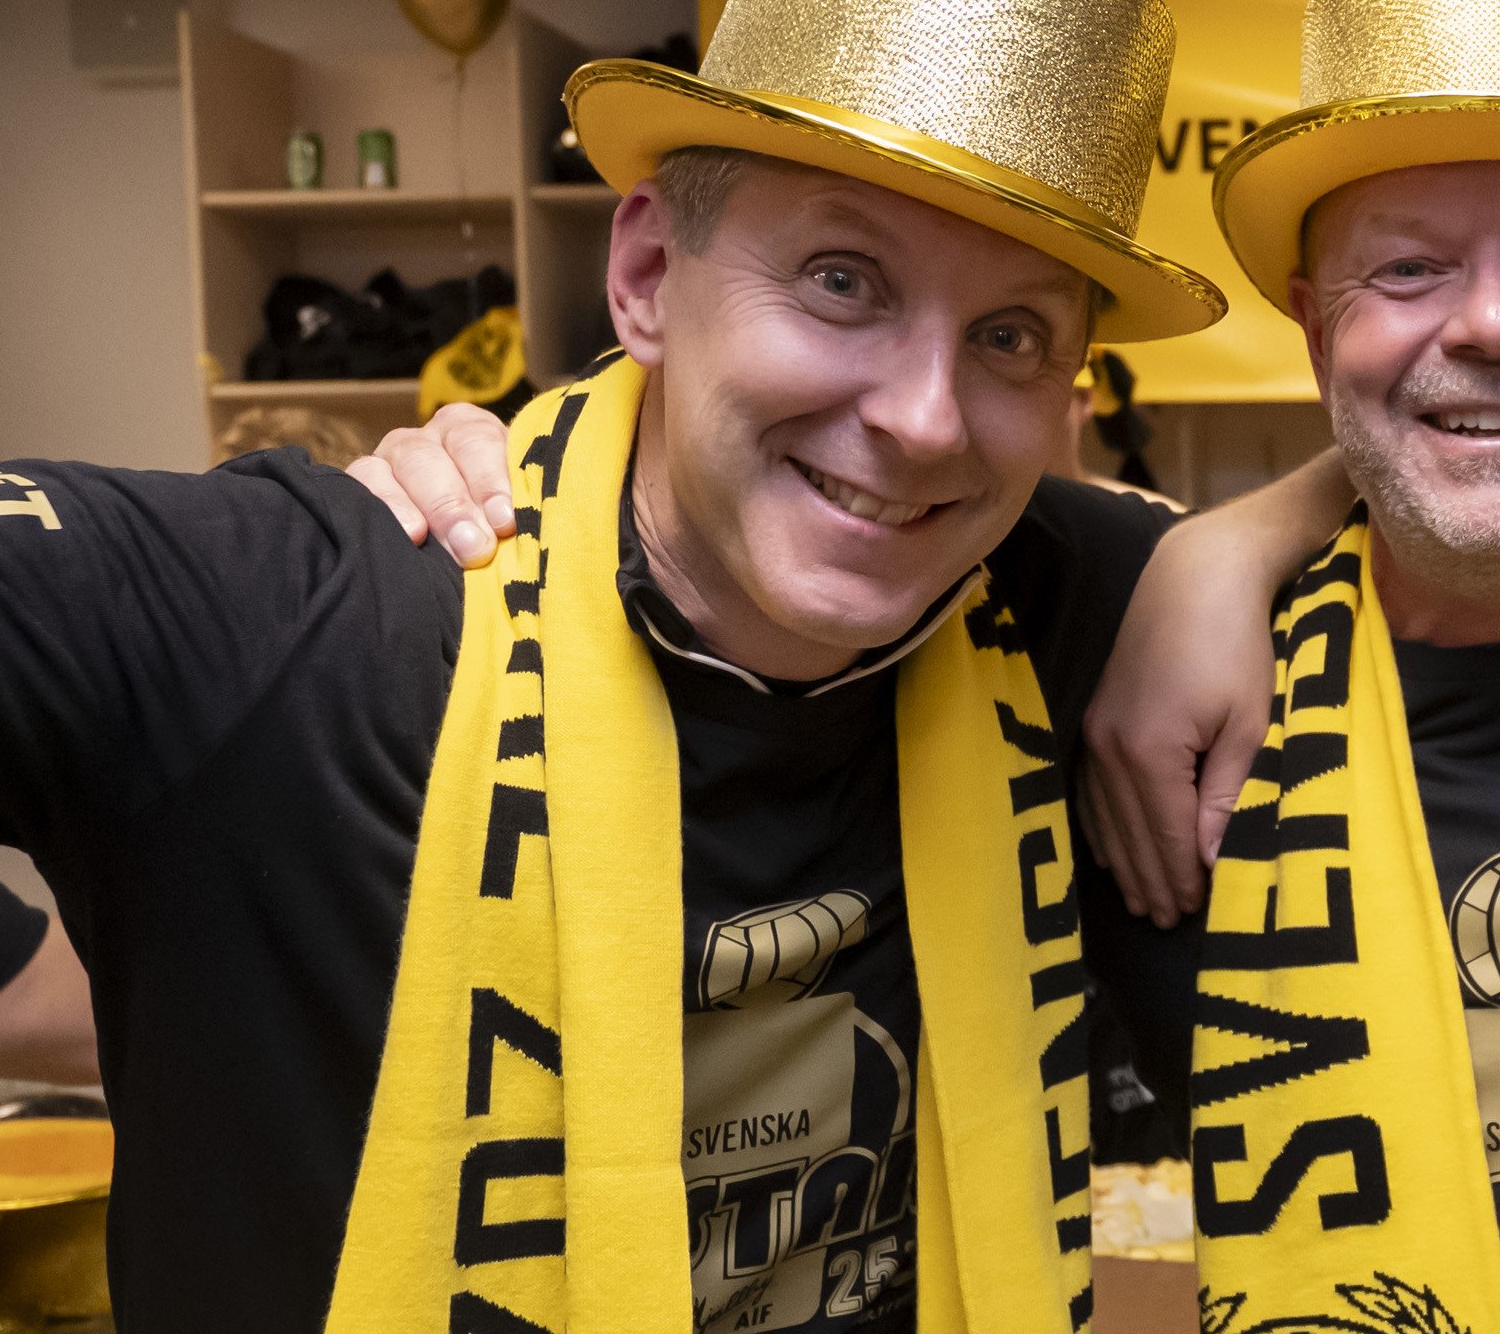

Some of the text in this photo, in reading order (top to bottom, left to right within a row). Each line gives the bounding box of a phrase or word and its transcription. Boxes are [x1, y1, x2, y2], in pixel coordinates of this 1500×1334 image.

[687, 1109, 811, 1158] SVENSKA
[825, 1235, 899, 1318] 25
[734, 1303, 773, 1330] AIF
